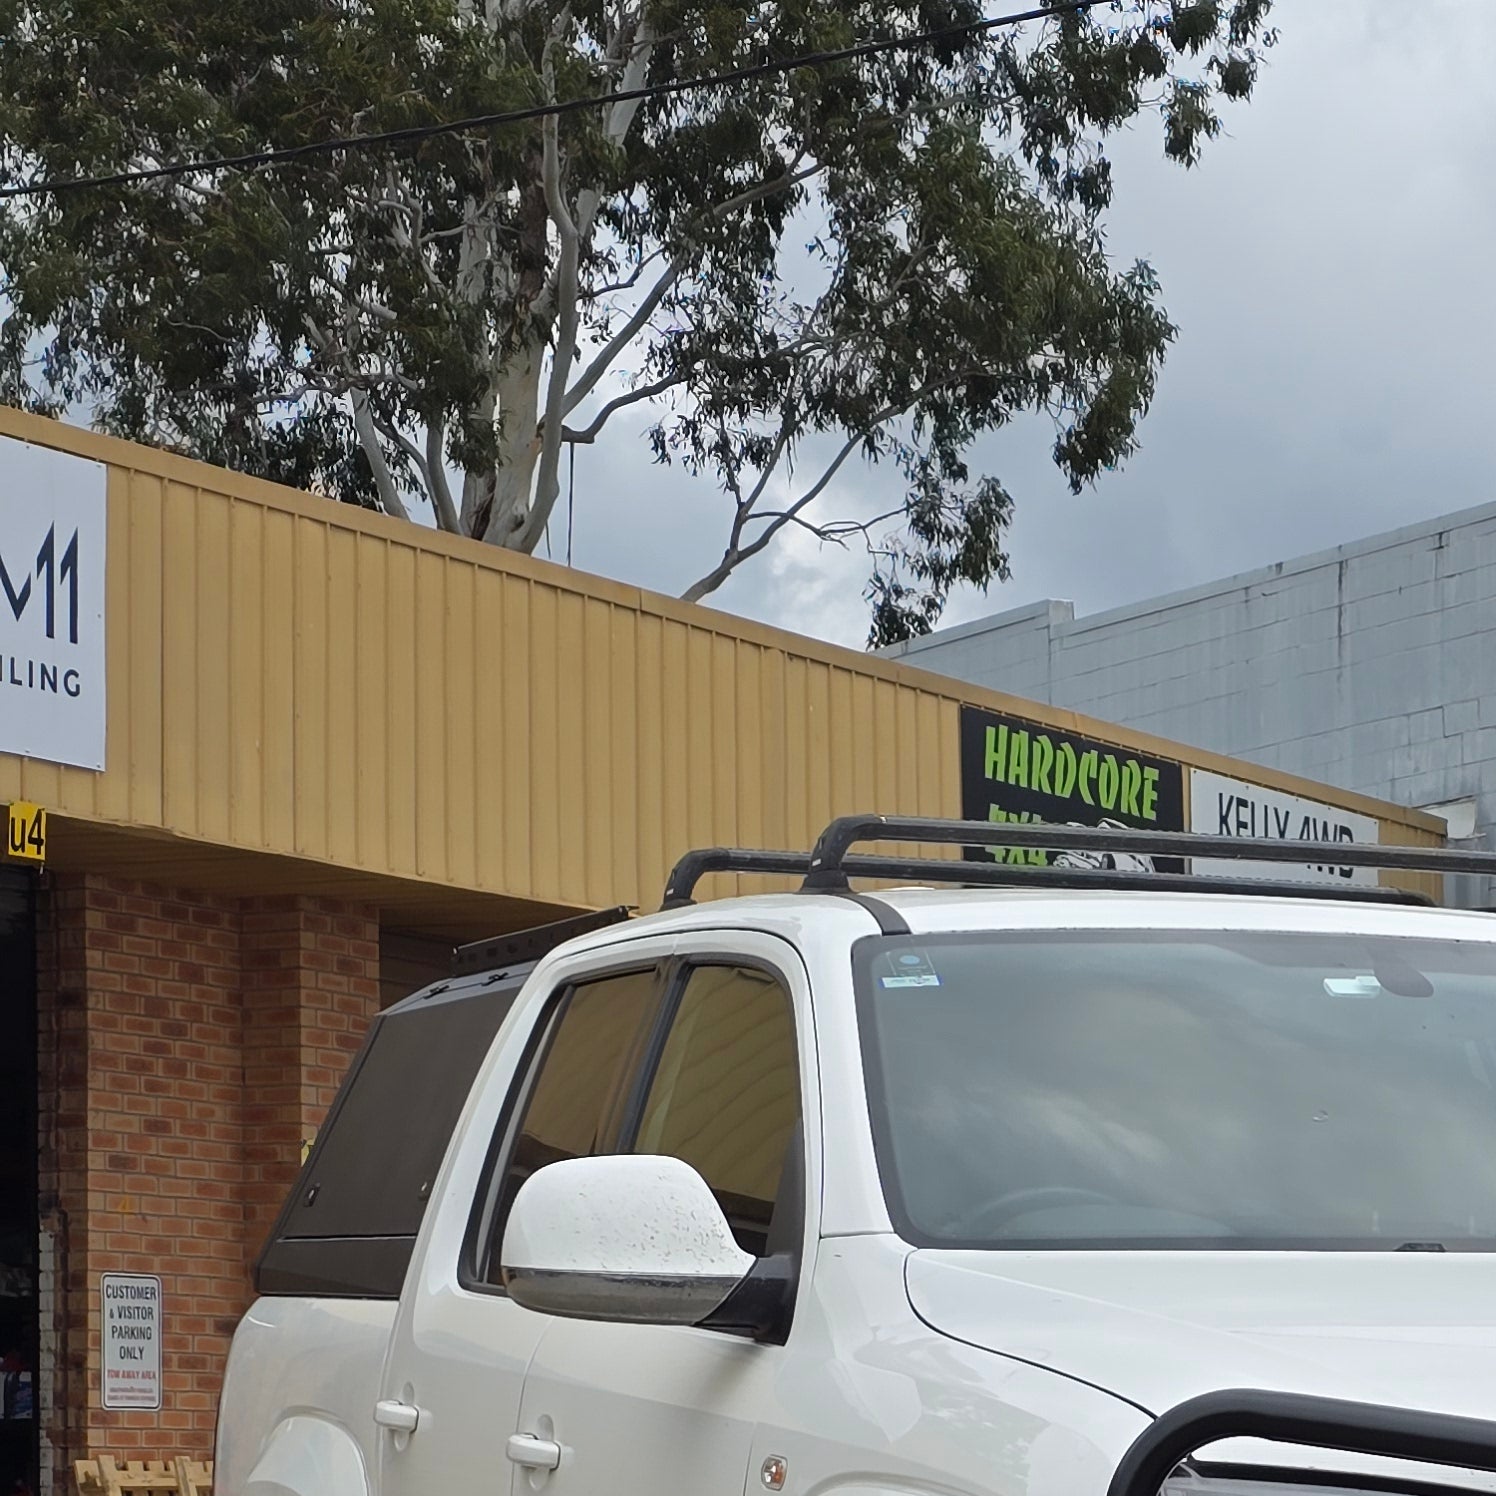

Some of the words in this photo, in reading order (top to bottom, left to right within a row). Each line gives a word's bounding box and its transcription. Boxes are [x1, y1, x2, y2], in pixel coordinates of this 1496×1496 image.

[984, 724, 1160, 821] HARDCORE
[105, 1284, 157, 1301] CUSTOMER
[117, 1305, 154, 1321] VISITOR
[111, 1325, 152, 1341] PARKING
[119, 1346, 145, 1360] ONLY
